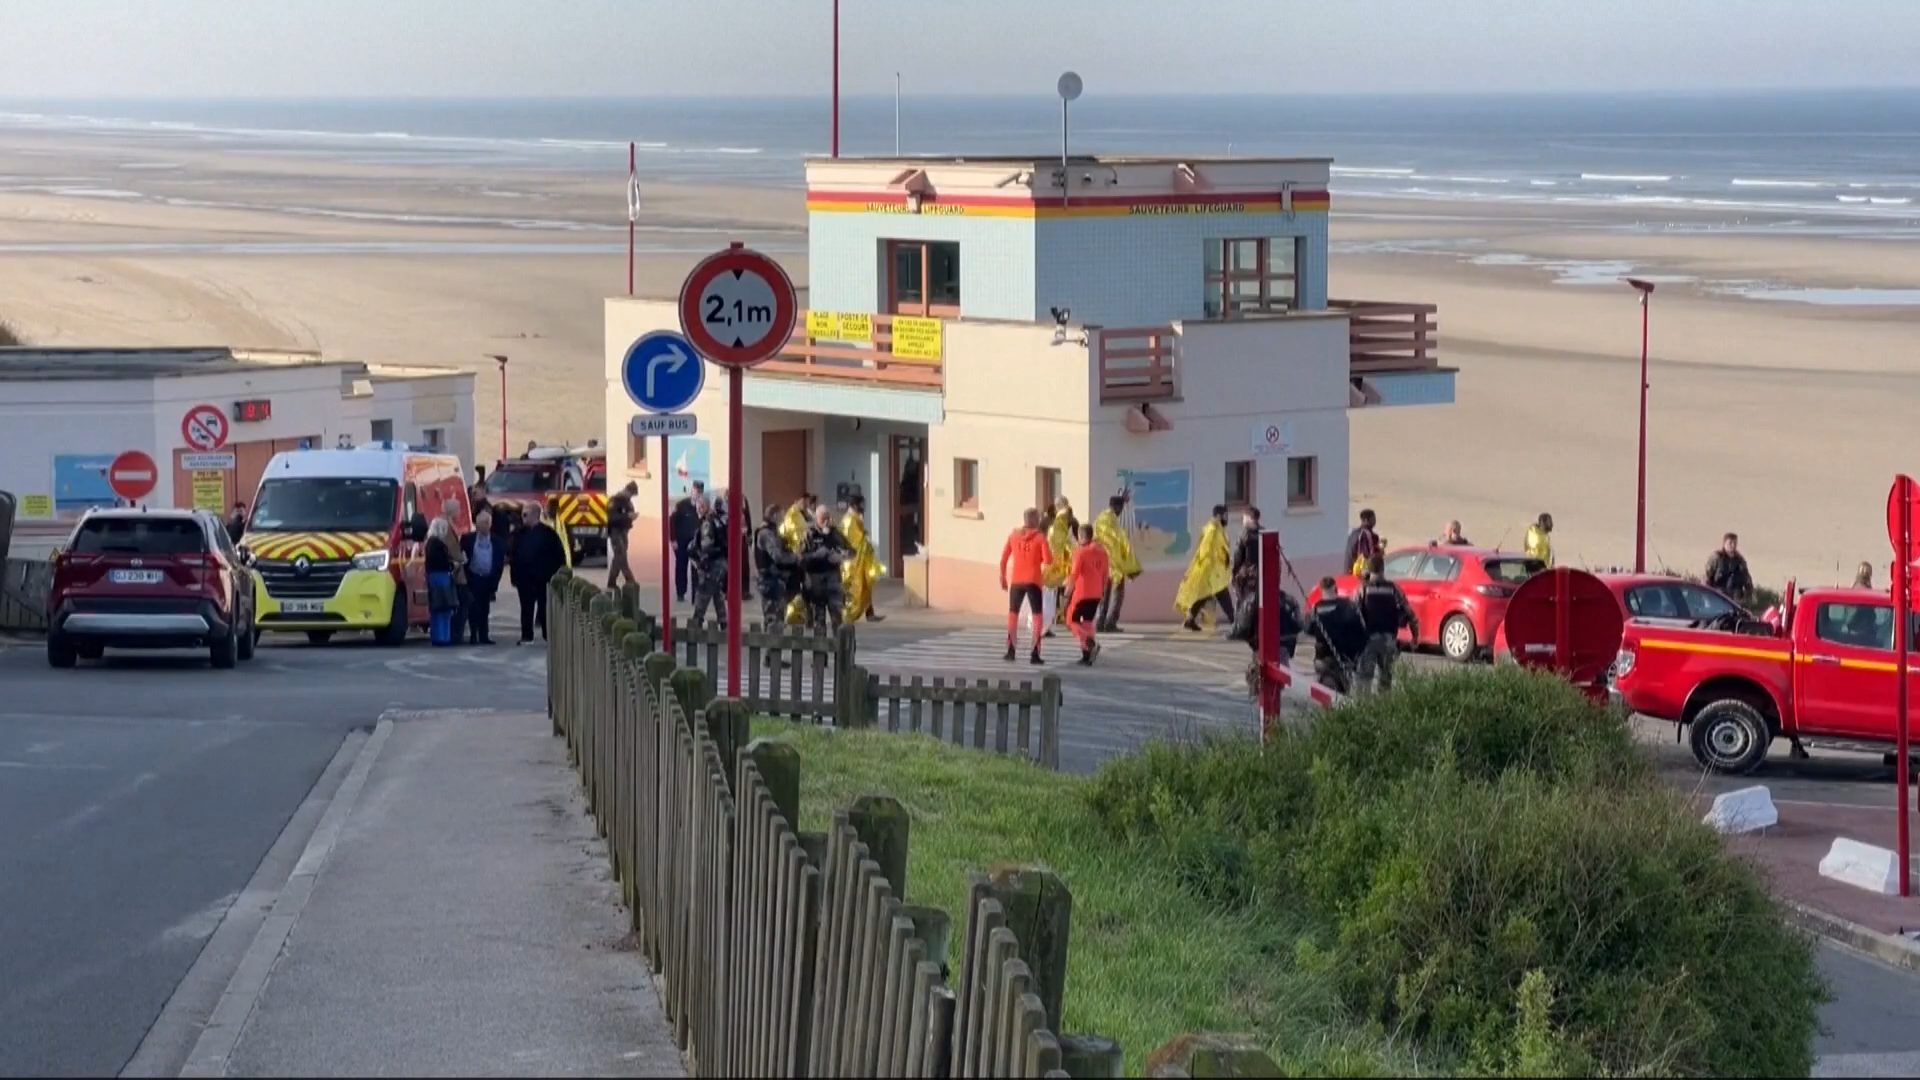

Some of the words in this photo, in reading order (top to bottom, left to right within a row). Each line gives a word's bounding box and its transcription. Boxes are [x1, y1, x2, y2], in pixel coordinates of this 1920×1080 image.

[922, 204, 964, 214] LIFEGUARD
[1129, 204, 1188, 215] SAUVETEURS
[1195, 203, 1245, 213] LIFEGUARD
[706, 294, 771, 327] 2,1m
[841, 312, 859, 321] POSTE
[860, 313, 868, 322] DE
[842, 322, 868, 331] SECOURS
[640, 420, 665, 431] SAUF
[668, 420, 689, 430] BUS
